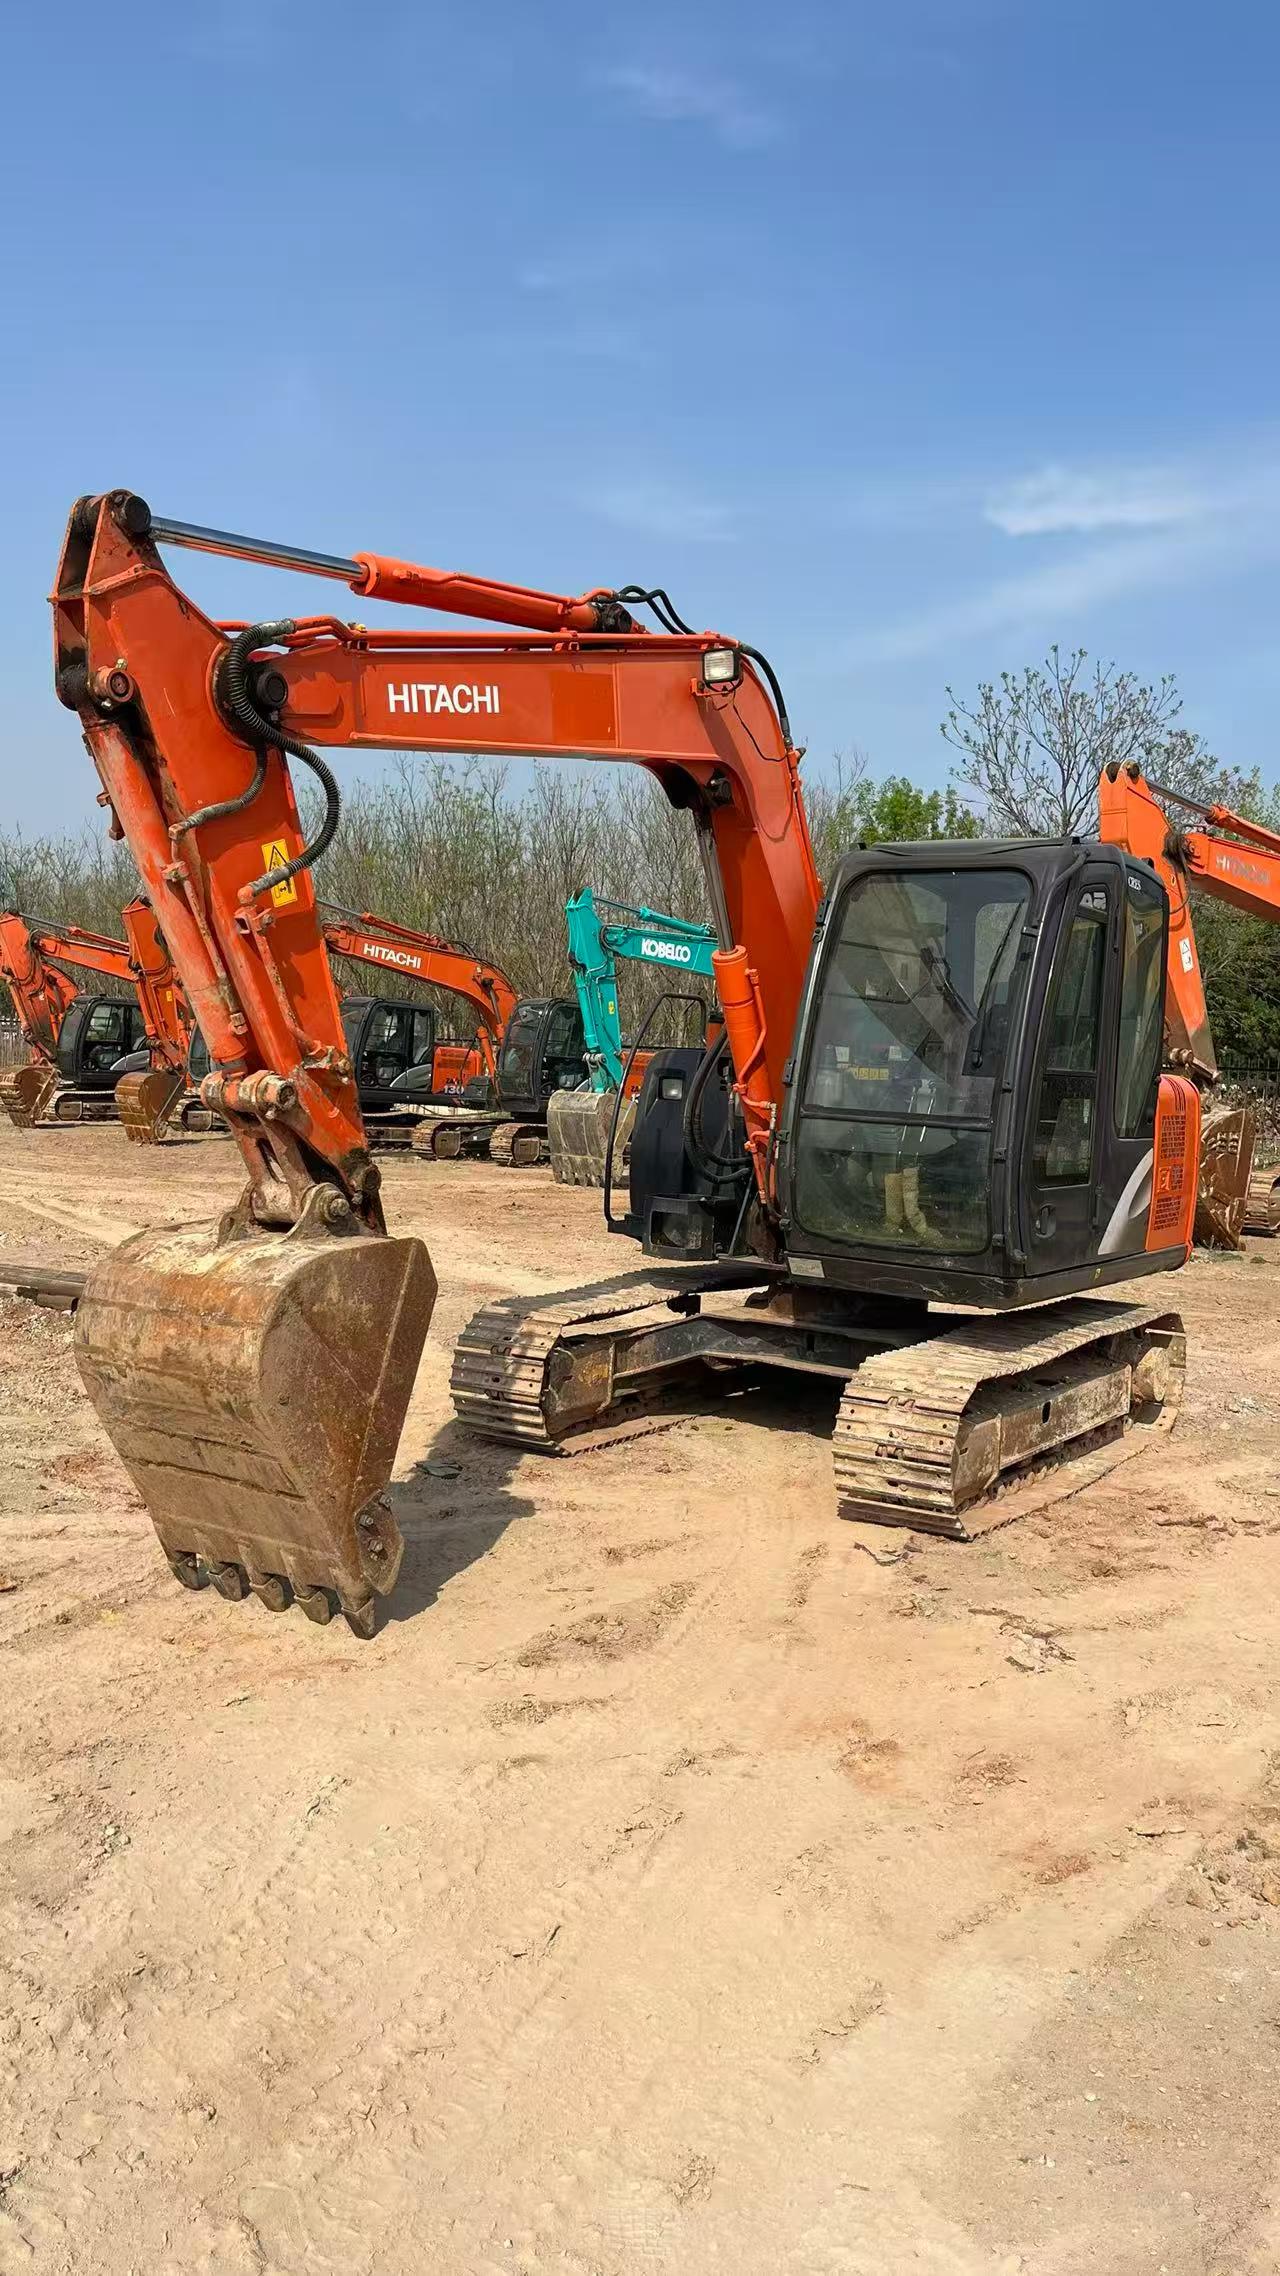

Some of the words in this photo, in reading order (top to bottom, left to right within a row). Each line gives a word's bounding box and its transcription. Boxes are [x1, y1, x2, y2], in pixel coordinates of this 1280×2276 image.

[387, 683, 500, 714] HITACHI
[363, 943, 421, 969] HITACHI
[641, 938, 691, 963] KOBELCO
